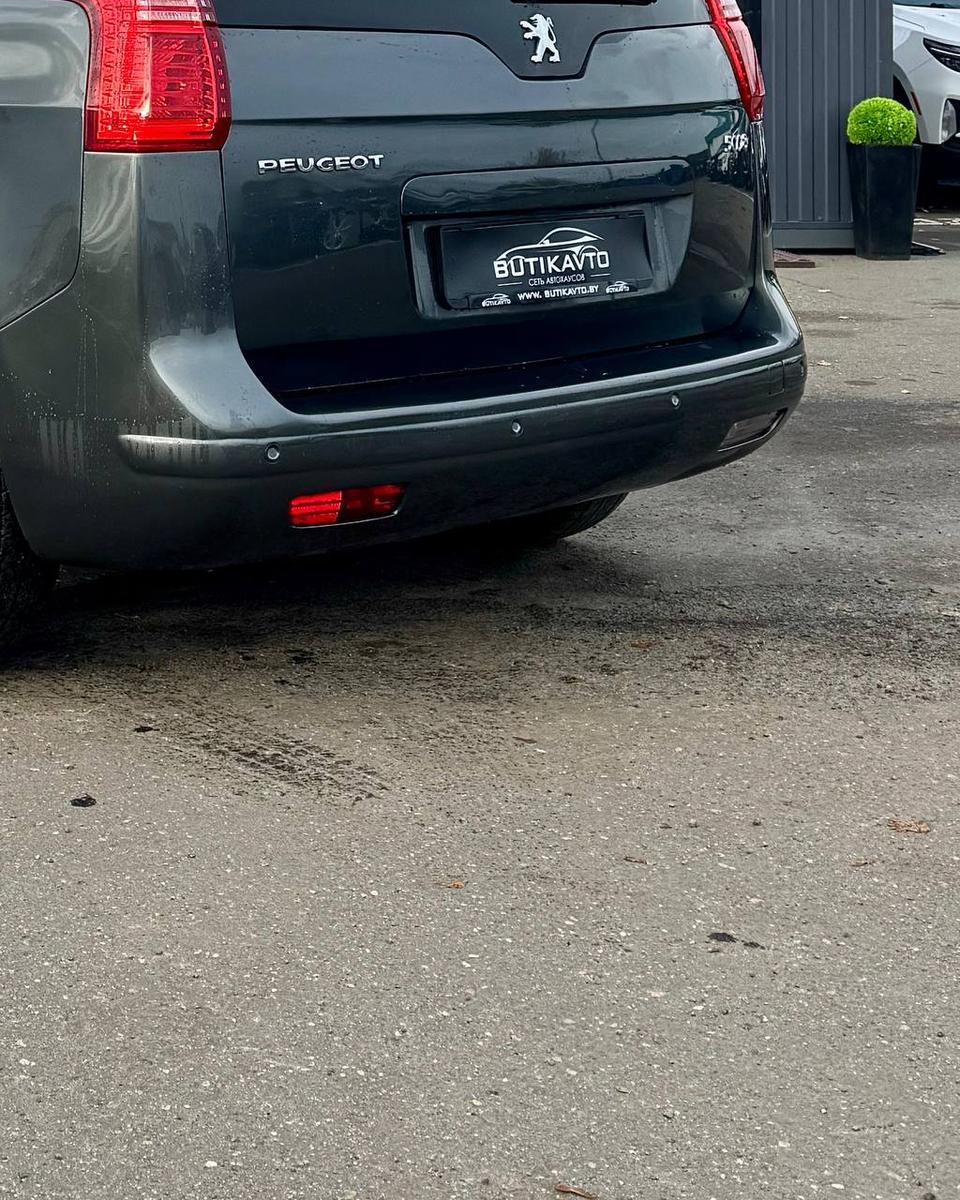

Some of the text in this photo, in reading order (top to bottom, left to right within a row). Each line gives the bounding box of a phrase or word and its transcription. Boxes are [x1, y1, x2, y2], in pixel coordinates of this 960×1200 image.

[258, 155, 384, 174] PEUGEOT
[493, 251, 610, 279] BUTIKAVTO
[528, 273, 586, 287] СЕТЬ АВТОХАУСОВ
[544, 285, 600, 298] BUTIKAVTO.BY
